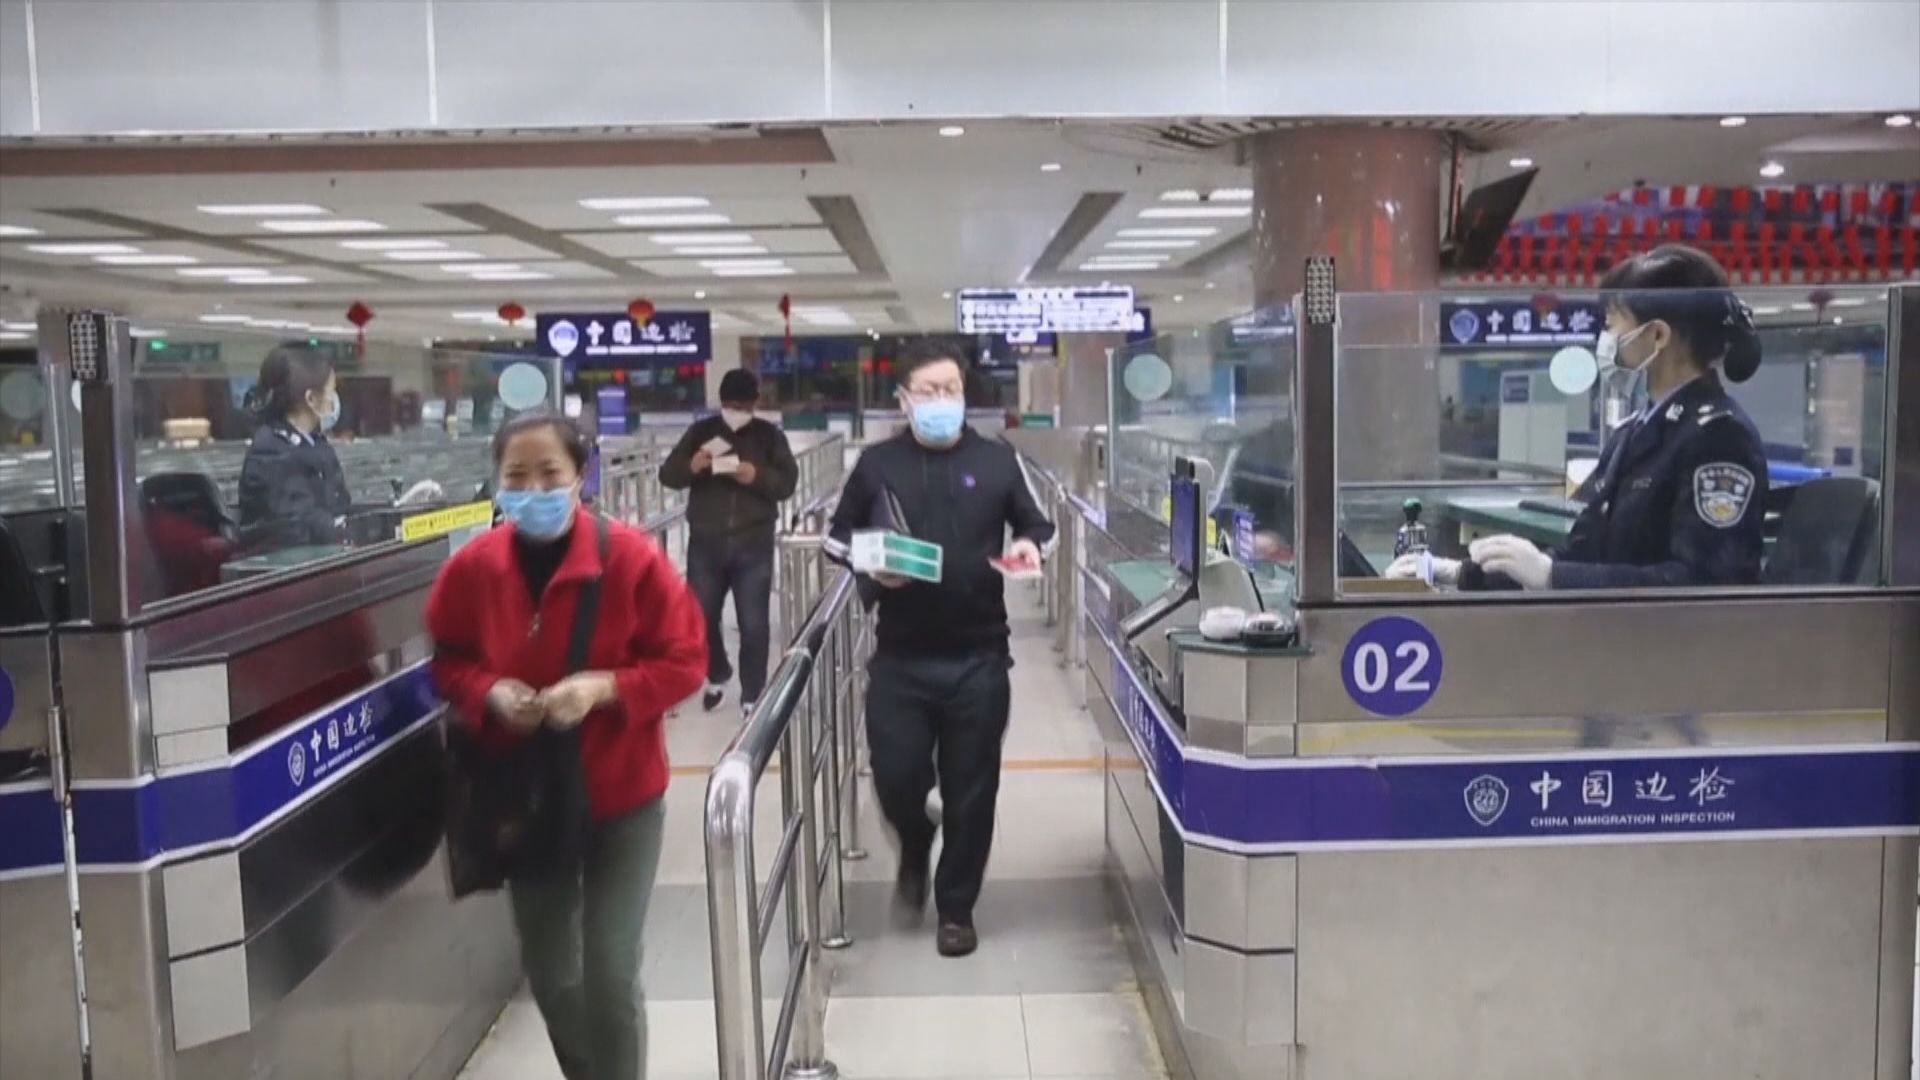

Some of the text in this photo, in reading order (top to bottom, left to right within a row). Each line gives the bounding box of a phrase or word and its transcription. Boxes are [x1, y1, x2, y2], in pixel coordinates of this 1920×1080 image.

[1353, 641, 1430, 693] 02
[310, 700, 373, 763] 中国边检
[1529, 766, 1736, 811] 中国边检
[1530, 811, 1736, 828] CHINA IMMIGRATION INSPECTION
